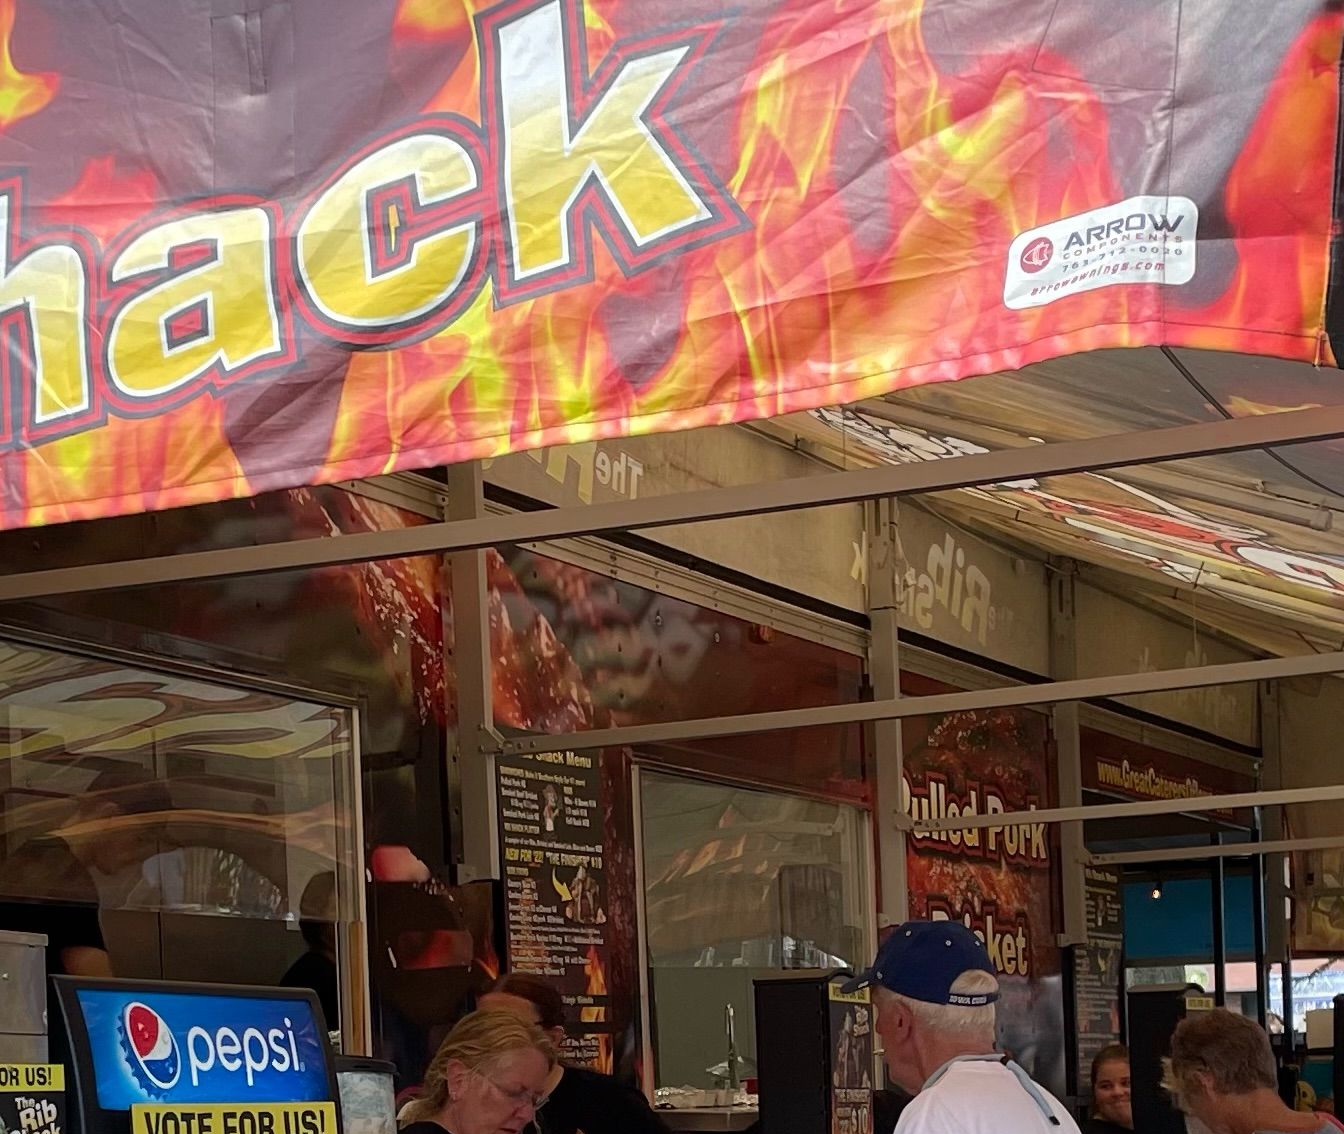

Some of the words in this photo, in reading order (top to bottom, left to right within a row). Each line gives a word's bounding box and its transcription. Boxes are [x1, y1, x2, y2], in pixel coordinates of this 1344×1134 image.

[1062, 233, 1184, 260] COMPONENTS
[1063, 213, 1185, 252] ARROW
[1030, 261, 1165, 297] arrowawnings.com
[566, 750, 593, 769] Menu
[187, 1017, 301, 1087] pepsi
[25, 1066, 52, 1087] US!
[14, 1095, 36, 1111] The
[19, 1099, 58, 1132] Rib
